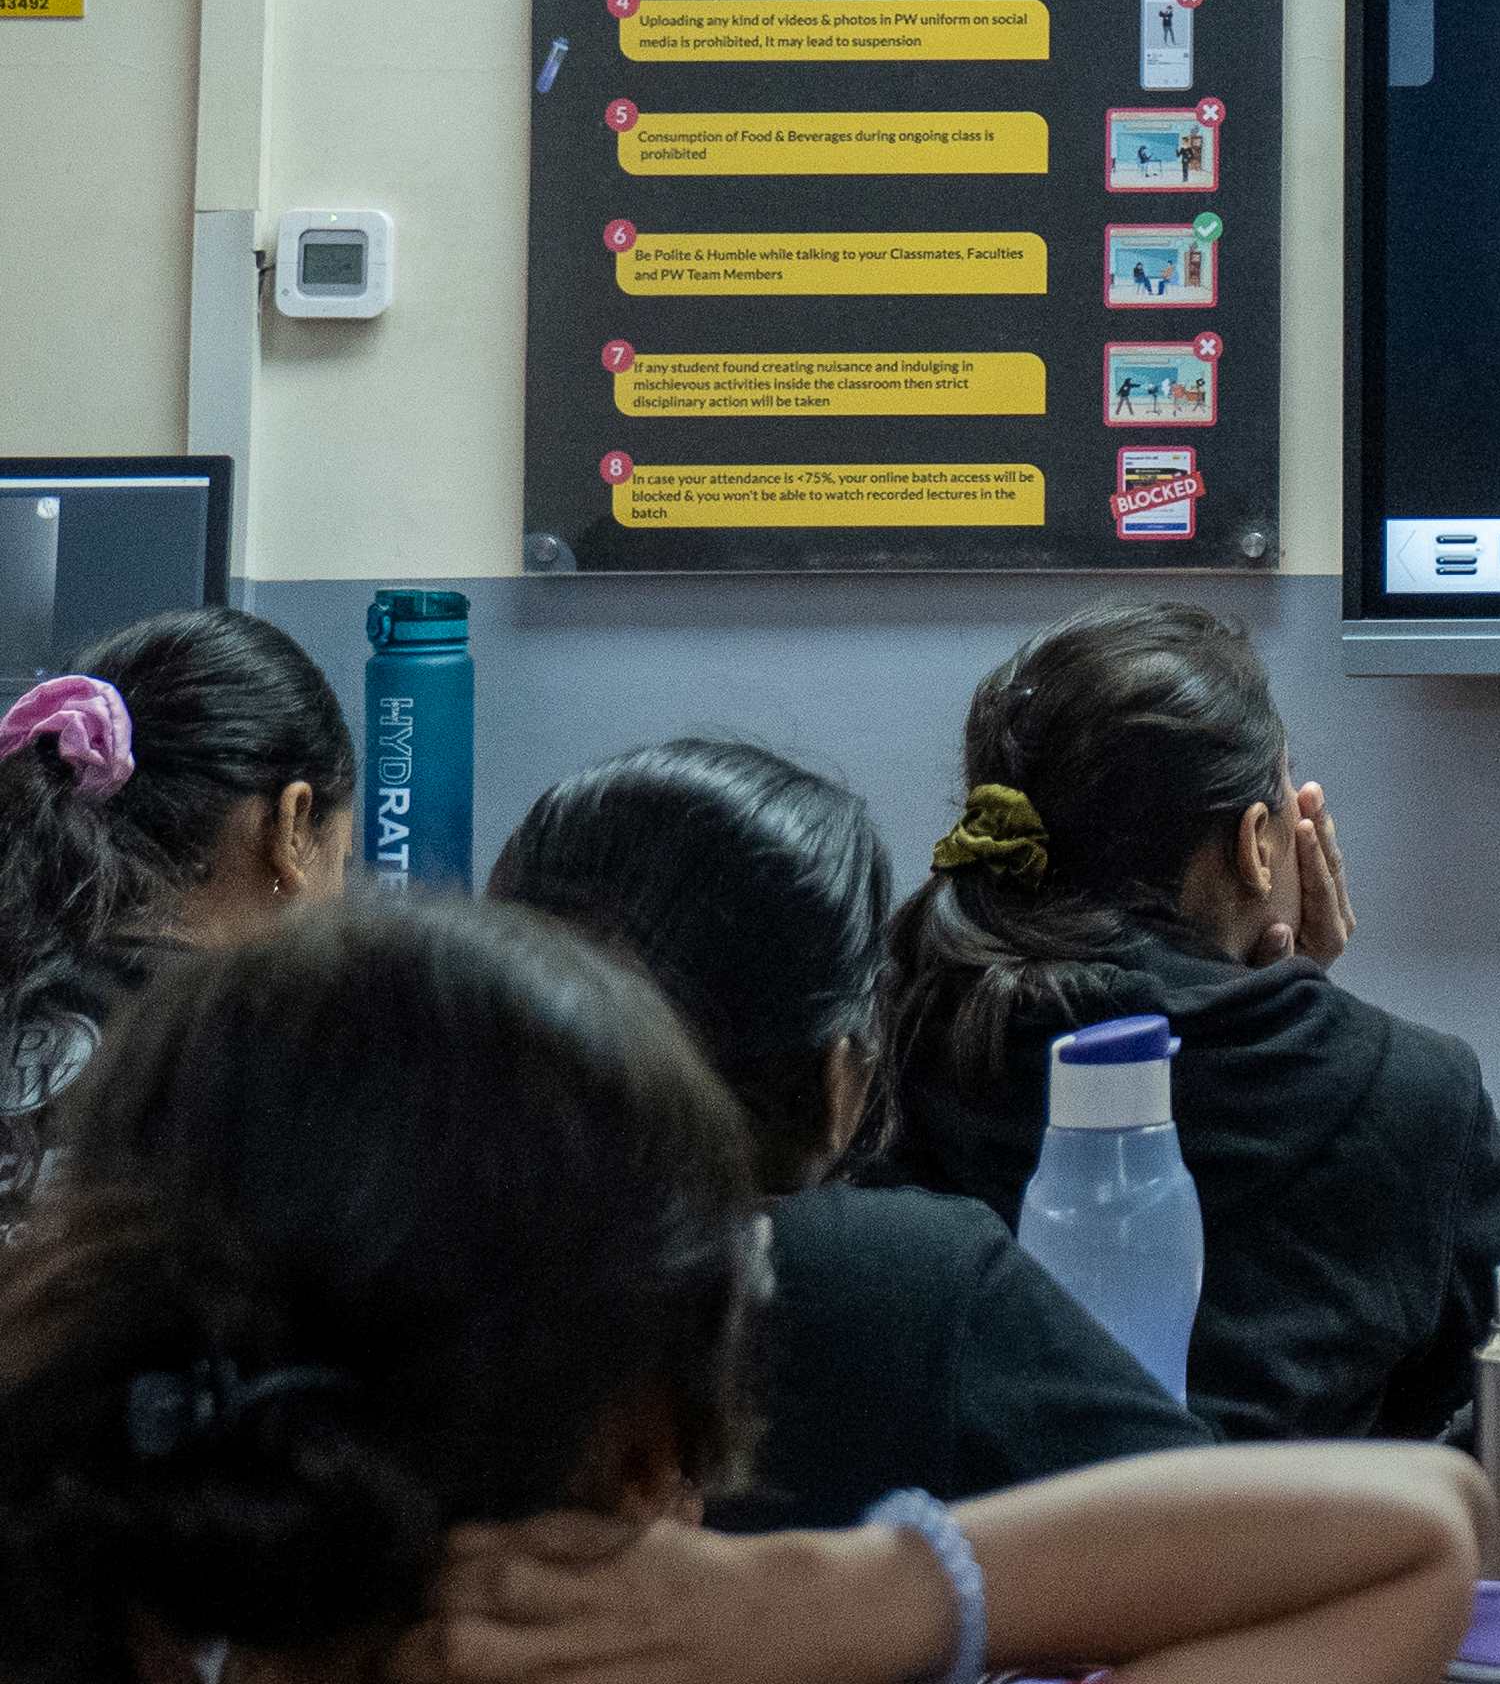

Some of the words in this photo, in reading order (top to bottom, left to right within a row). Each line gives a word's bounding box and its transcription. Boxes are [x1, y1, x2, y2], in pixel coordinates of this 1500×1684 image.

[638, 14, 705, 29] Uploading
[706, 16, 730, 28] any
[731, 14, 760, 27] kind
[761, 13, 776, 27] of
[777, 14, 819, 27] videos
[820, 13, 832, 26] &
[833, 14, 878, 28] photos
[879, 13, 892, 26] in
[894, 12, 918, 26] PW
[919, 13, 971, 26] uniform
[972, 15, 990, 26] on
[991, 12, 1028, 26] social
[616, 105, 628, 124] 5
[637, 130, 723, 145] Consumption
[724, 130, 739, 143] of
[740, 129, 773, 143] Food
[774, 130, 785, 143] &
[787, 129, 853, 145] Beverages
[854, 129, 897, 145] during
[898, 129, 949, 145] ongoing
[950, 129, 982, 142] class
[984, 129, 995, 142] is
[640, 147, 707, 162] prohibited
[613, 226, 627, 245] 6
[634, 249, 652, 262] Be
[654, 248, 692, 262] Polite
[693, 248, 705, 262] &
[706, 248, 757, 262] Humble
[758, 248, 794, 261] while
[795, 247, 840, 263] talking
[842, 249, 857, 261] to
[858, 250, 888, 262] your
[889, 247, 965, 262] Classmates,
[966, 247, 1024, 260] Faculties
[634, 268, 659, 282] and
[660, 268, 685, 281] PW
[686, 268, 721, 281] Team
[723, 268, 784, 281] Members
[611, 346, 625, 365] 7
[609, 458, 623, 477] 8
[1117, 478, 1198, 513] BLOCKED
